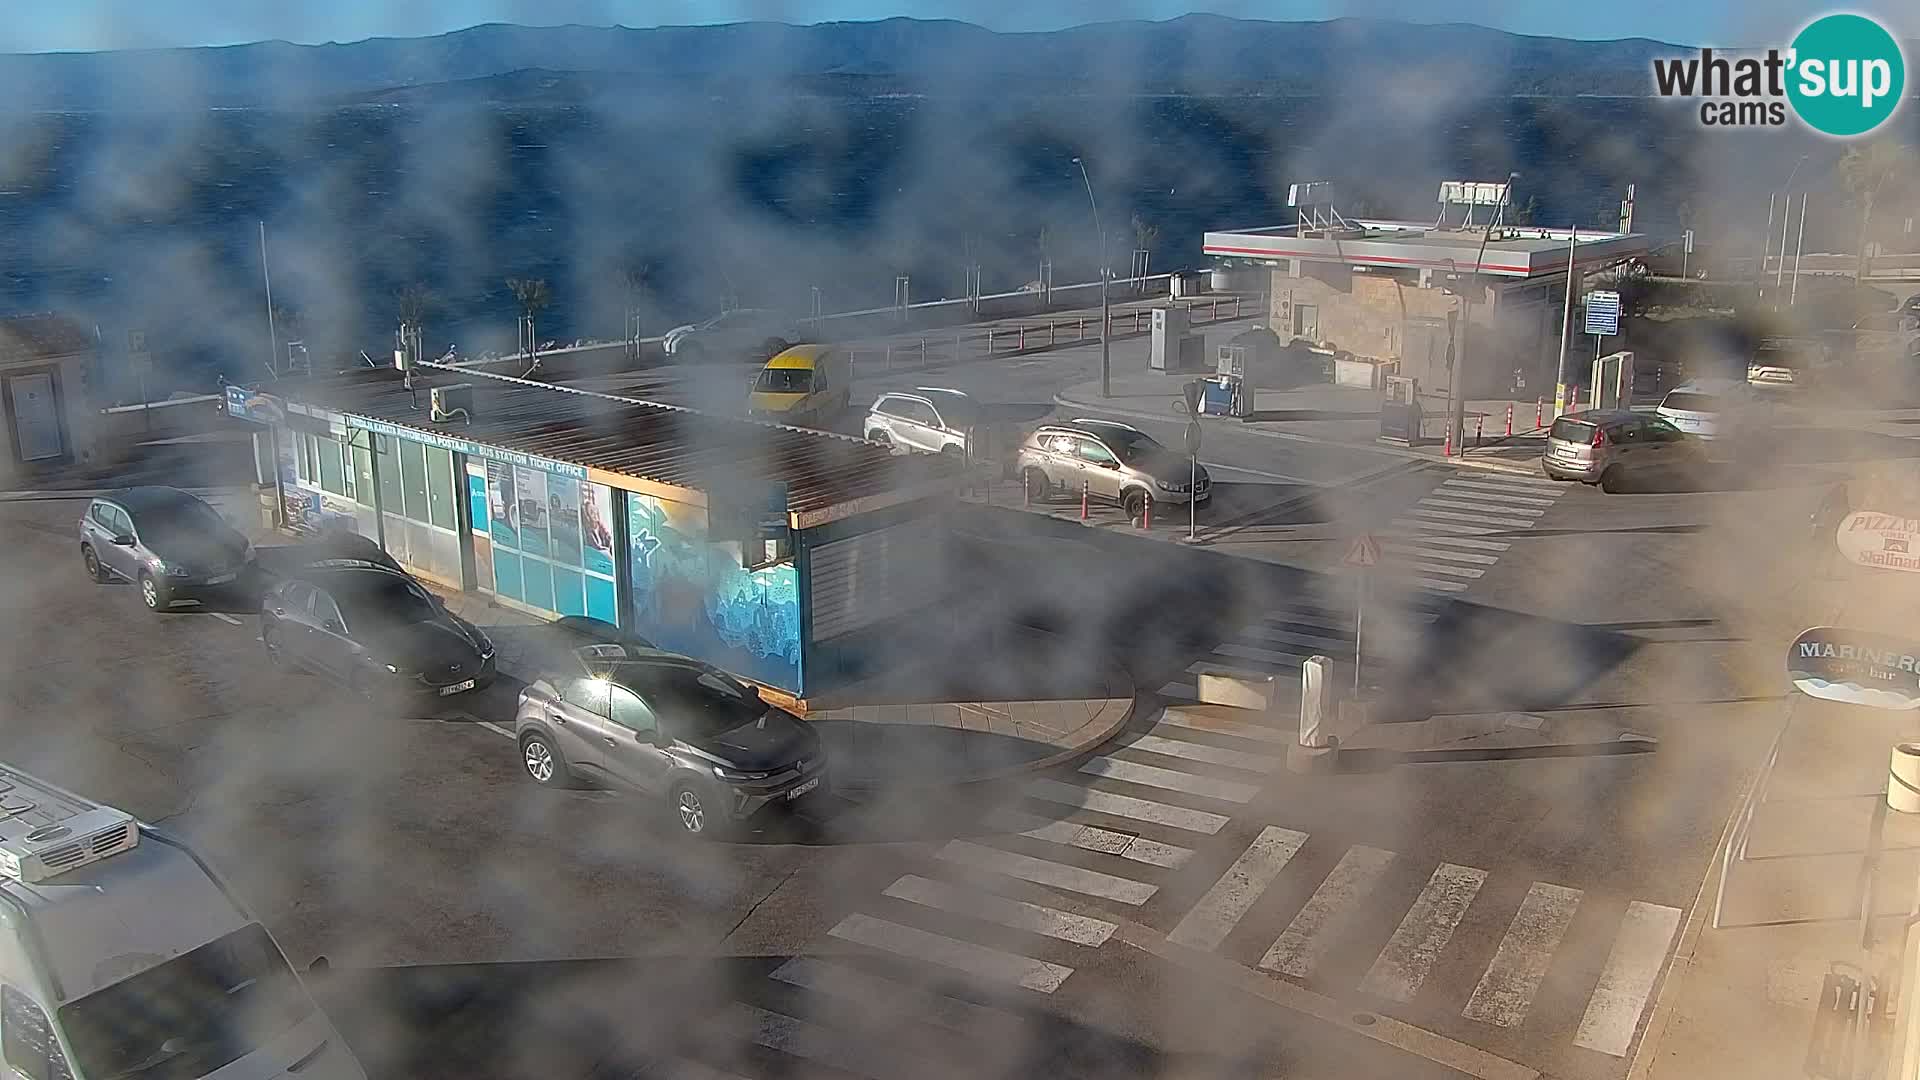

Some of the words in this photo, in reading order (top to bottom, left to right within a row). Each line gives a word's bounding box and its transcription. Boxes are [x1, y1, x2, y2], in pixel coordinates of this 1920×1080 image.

[437, 436, 469, 453] POSTAJA
[478, 446, 494, 458] BUS
[495, 450, 527, 465] STATION
[529, 456, 555, 471] TICKET
[556, 463, 584, 477] OFFICE
[1869, 665, 1896, 681] bar
